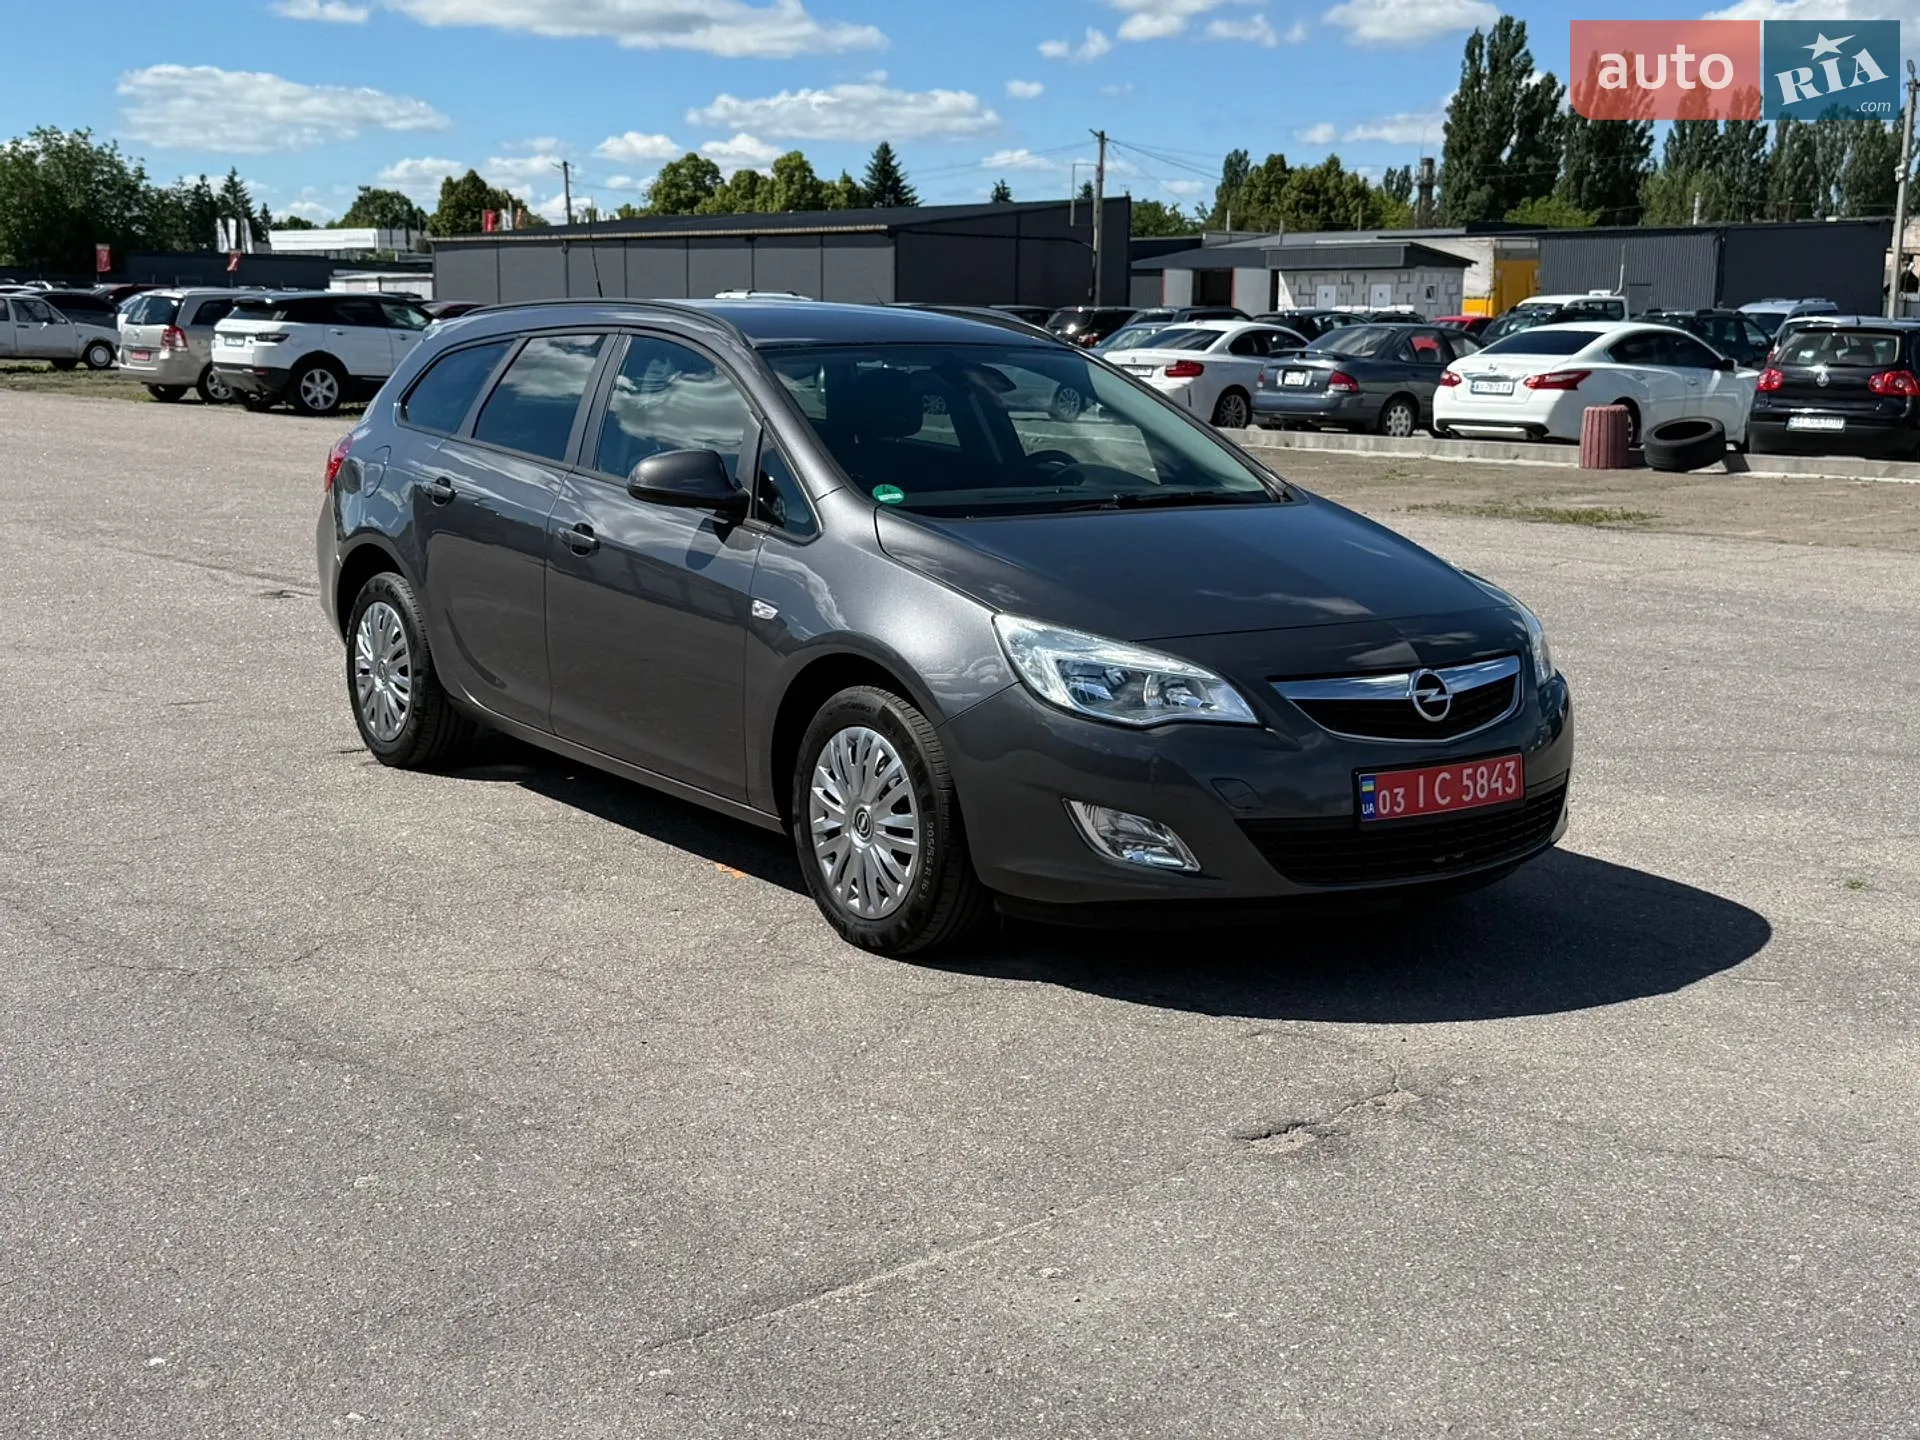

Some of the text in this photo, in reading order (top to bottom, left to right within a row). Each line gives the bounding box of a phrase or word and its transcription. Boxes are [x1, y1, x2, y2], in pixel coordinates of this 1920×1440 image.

[1379, 787, 1405, 814] 03
[1461, 760, 1516, 801] 5843
[1362, 803, 1375, 814] UA
